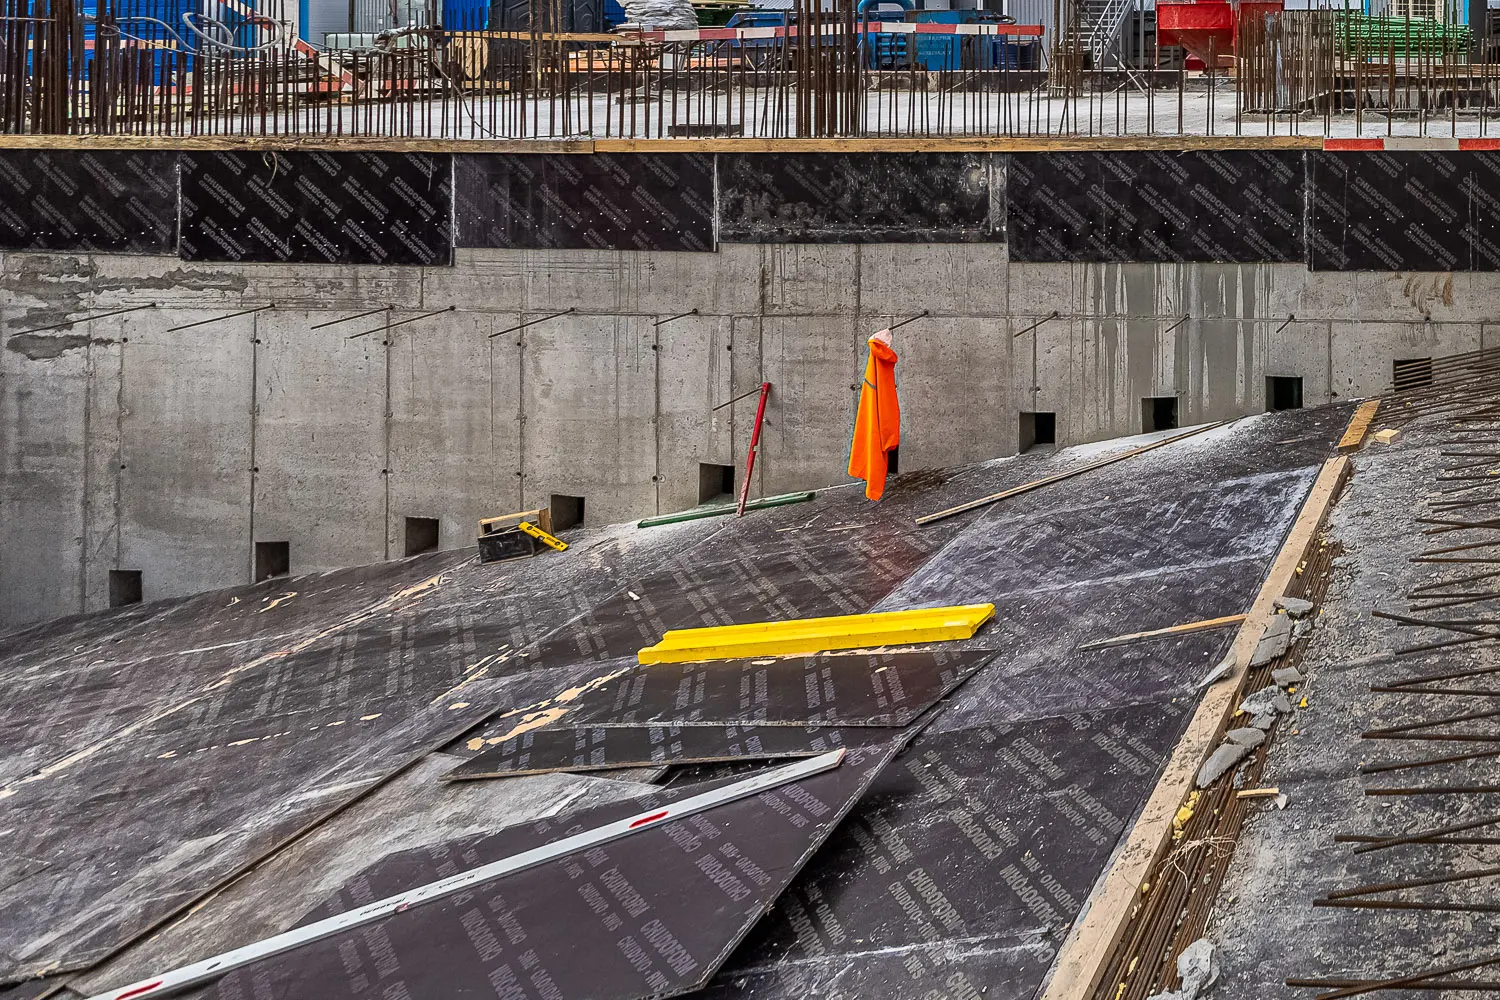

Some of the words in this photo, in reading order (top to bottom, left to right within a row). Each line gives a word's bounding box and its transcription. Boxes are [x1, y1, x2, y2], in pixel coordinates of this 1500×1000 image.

[203, 173, 246, 212] CHUDOFORM
[246, 180, 289, 219] CHUDOFORM
[298, 174, 341, 215] CHUDOFORM
[342, 180, 384, 220] CHUDOFORM
[394, 176, 436, 216] CHUDOFORM
[1194, 184, 1241, 224] CHUDOFORM
[1355, 176, 1404, 218] CHUDOFORM
[200, 221, 241, 260] CHUDOFORM
[251, 216, 294, 256] CHUDOFORM
[294, 224, 336, 262] CHUDOFORM
[346, 218, 388, 258] CHUDOFORM
[390, 224, 431, 264] CHUDOFORM
[1409, 222, 1458, 265] CHUDOFORM
[1012, 738, 1066, 780] CHUDOFORM
[1092, 732, 1150, 776] CHUDOFORM
[1066, 784, 1124, 834] CHUDOFORM
[600, 867, 649, 918] CHUDOFORM
[696, 854, 752, 902] CHUDOFORM
[1000, 864, 1063, 930] CHUDOFORM
[1040, 874, 1080, 914] CHUDOVO
[888, 881, 922, 924] CHUDOVO
[907, 867, 965, 934] CHUDOFORM
[617, 935, 652, 969] CHUDOVO
[640, 918, 698, 977] CHUDOFORM
